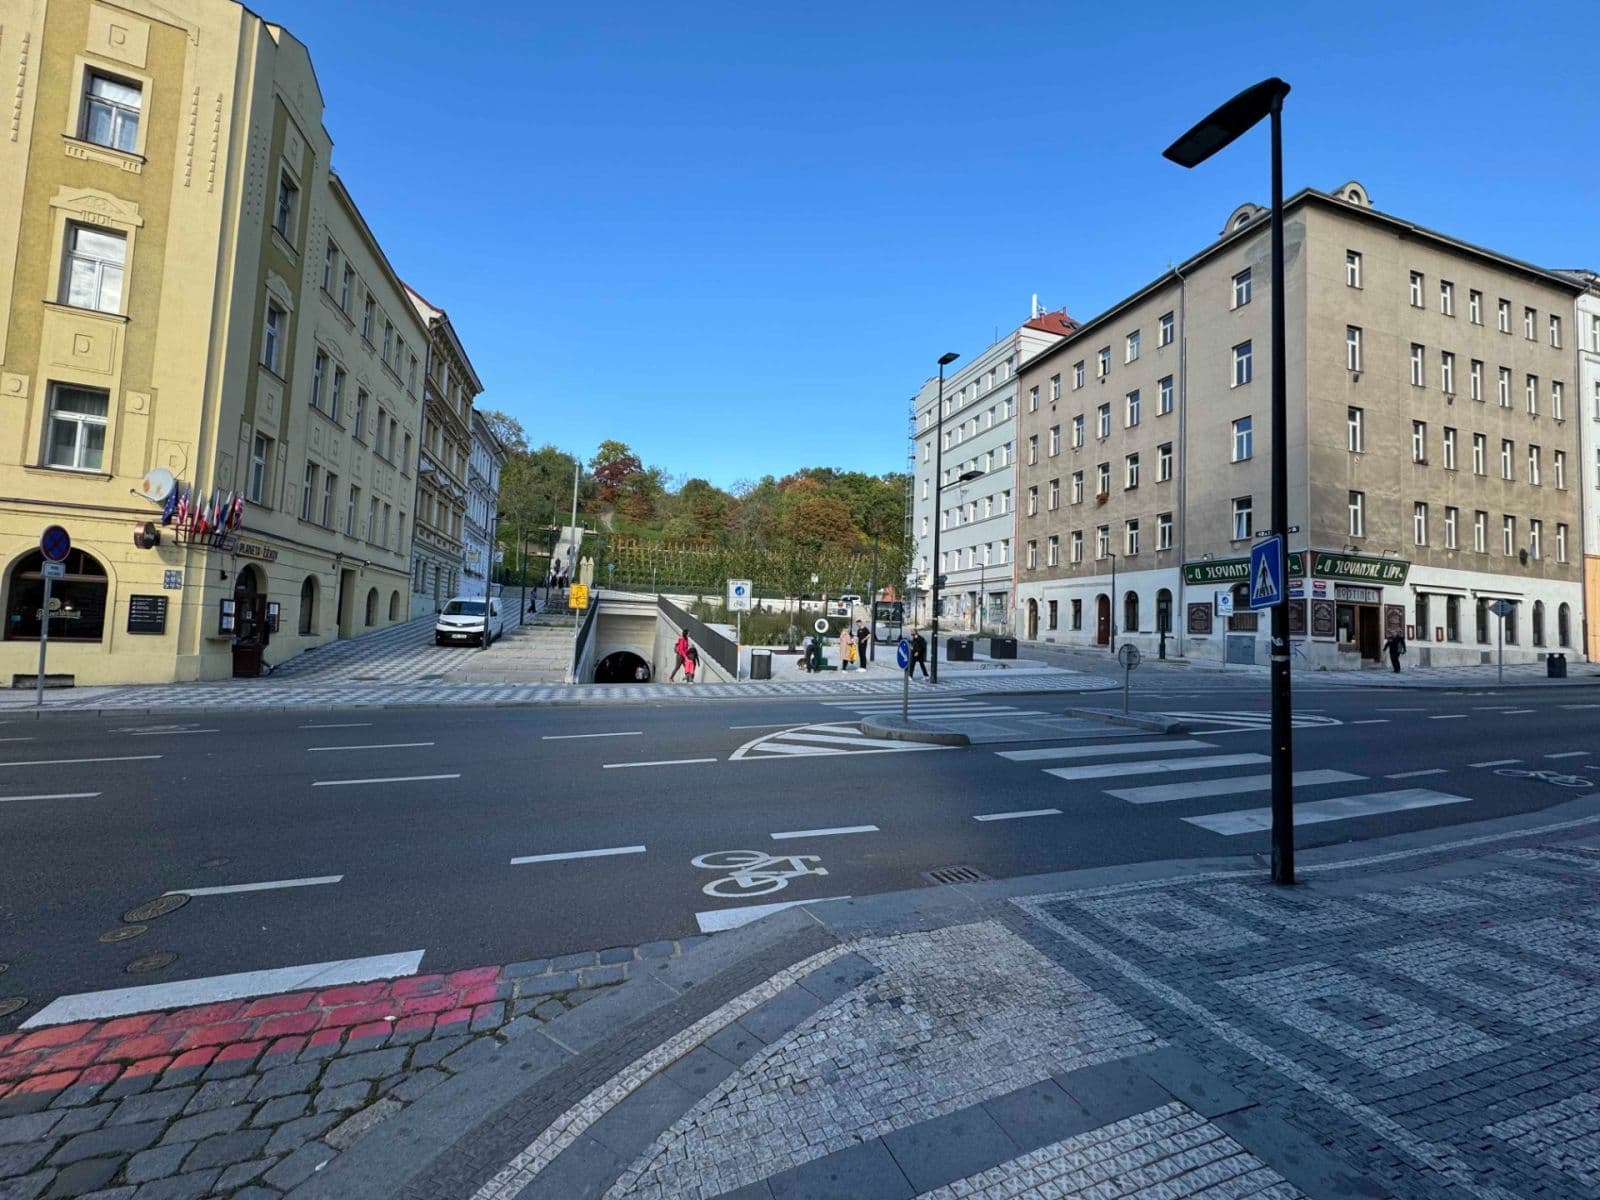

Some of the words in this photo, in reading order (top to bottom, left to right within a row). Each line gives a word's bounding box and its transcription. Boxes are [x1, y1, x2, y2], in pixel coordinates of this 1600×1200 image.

[1195, 568, 1202, 579] U
[1206, 563, 1251, 579] SLOVANS
[1324, 560, 1332, 572] U
[1335, 560, 1381, 577] SLOVANSKÉ
[1383, 563, 1401, 579] LÍPY
[1336, 587, 1378, 601] HOSTINEC
